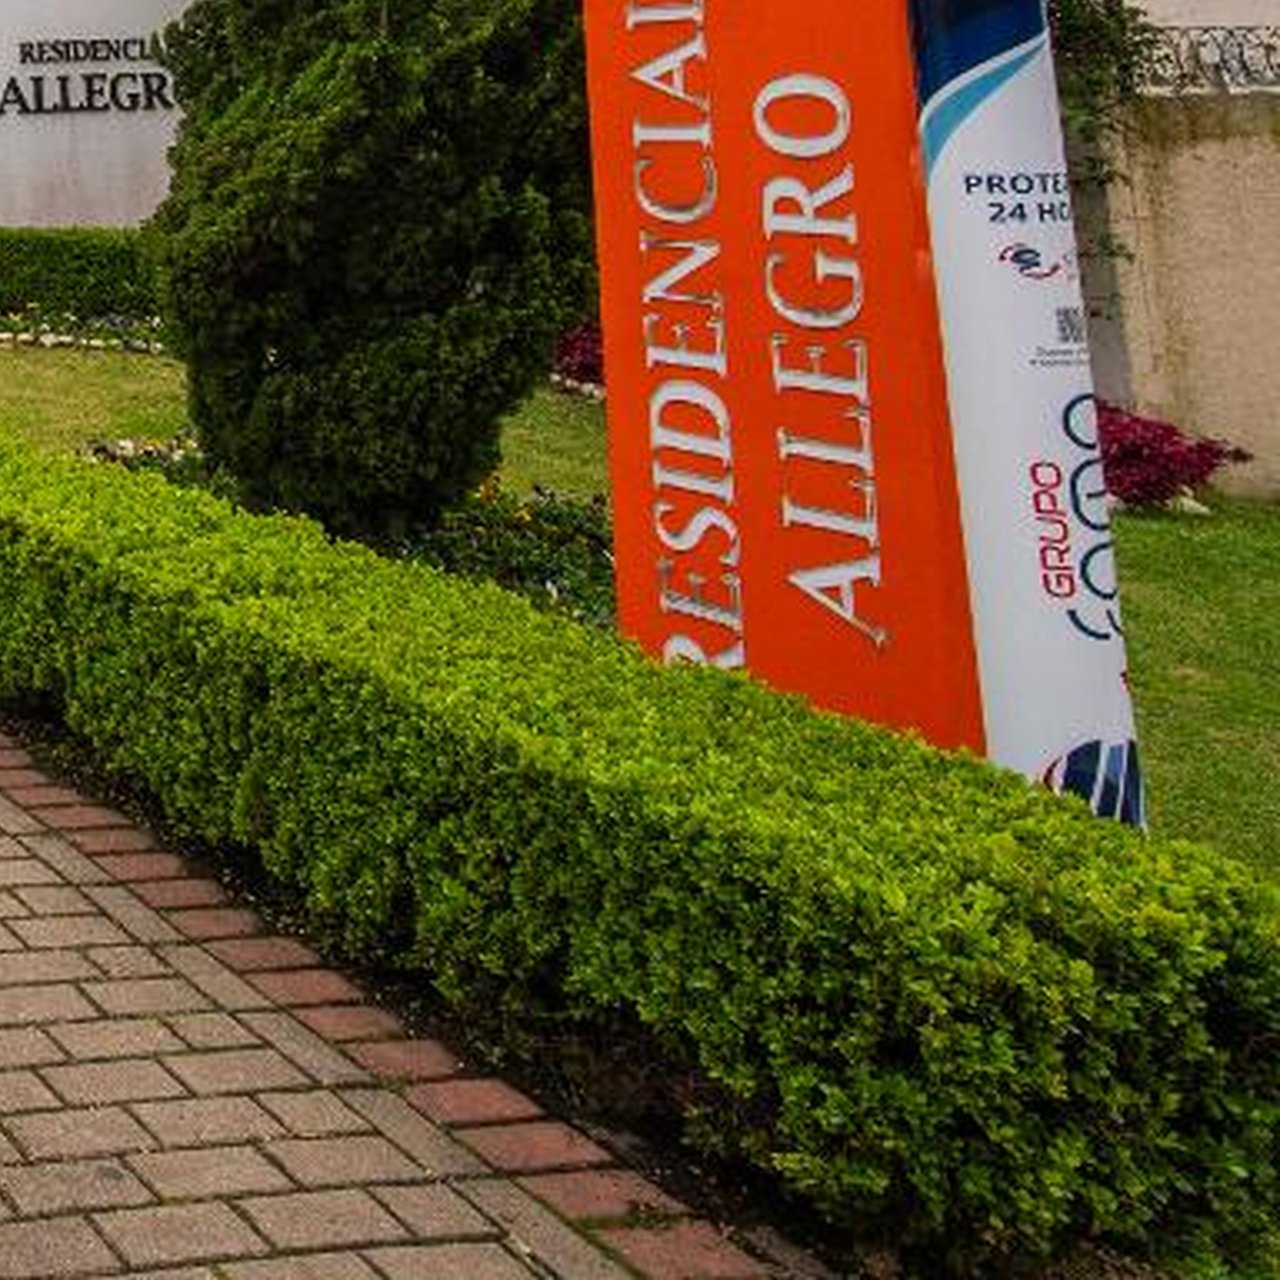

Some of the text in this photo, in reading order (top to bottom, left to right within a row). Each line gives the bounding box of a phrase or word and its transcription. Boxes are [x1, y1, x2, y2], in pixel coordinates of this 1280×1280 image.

[18, 37, 153, 65] RESIDENCI
[964, 172, 1069, 194] PROTE
[989, 202, 1028, 223] 24
[752, 71, 888, 650] ALLEGRO
[1030, 461, 1075, 598] GRUPO
